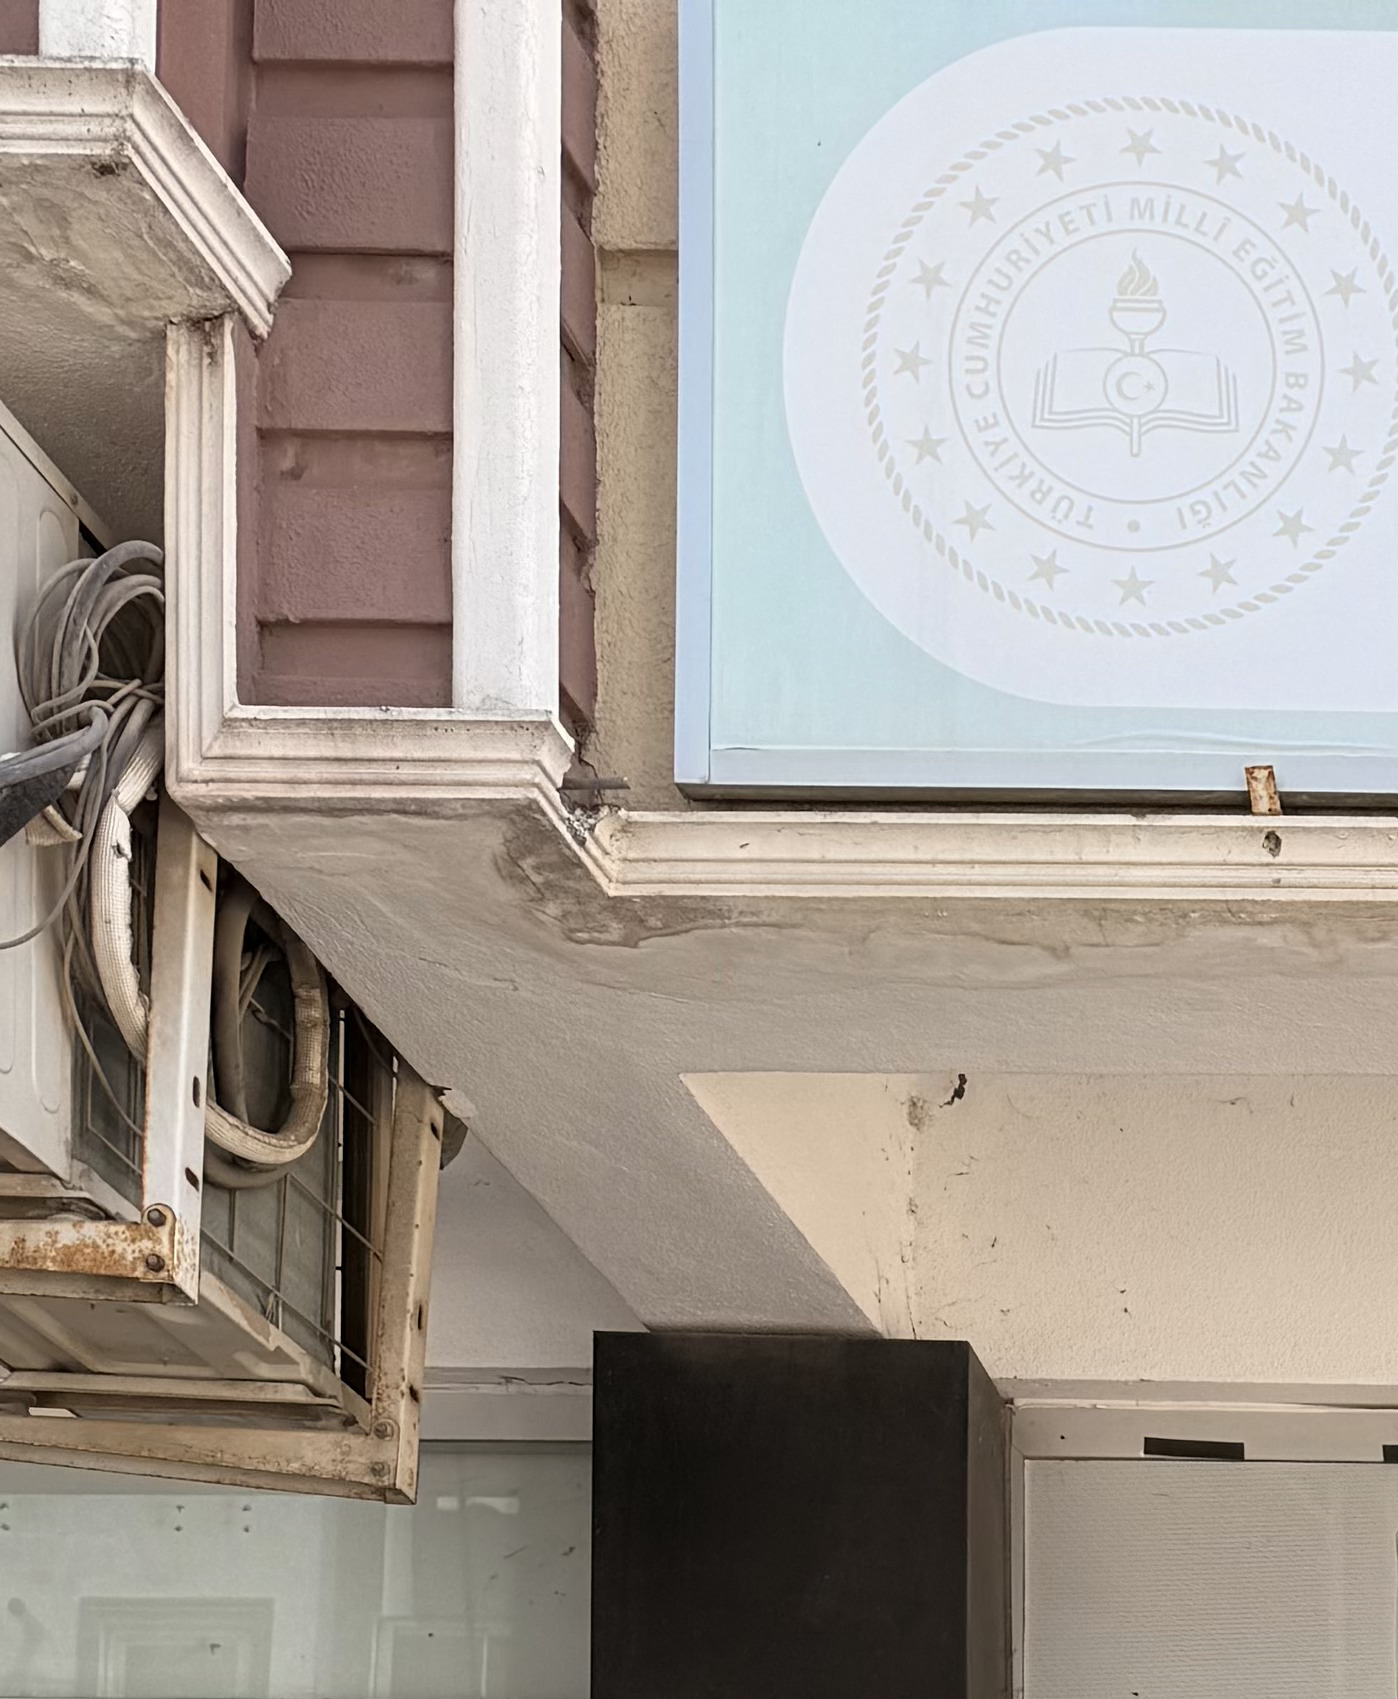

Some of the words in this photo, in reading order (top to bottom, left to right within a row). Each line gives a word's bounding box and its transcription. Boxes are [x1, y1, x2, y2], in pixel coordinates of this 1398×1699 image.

[965, 194, 1114, 399] CUMHURİYETİ
[1232, 237, 1310, 356] EĞİTİM
[975, 412, 1095, 530] TÜRKİYE
[1176, 371, 1309, 530] BAKANLIĞI
